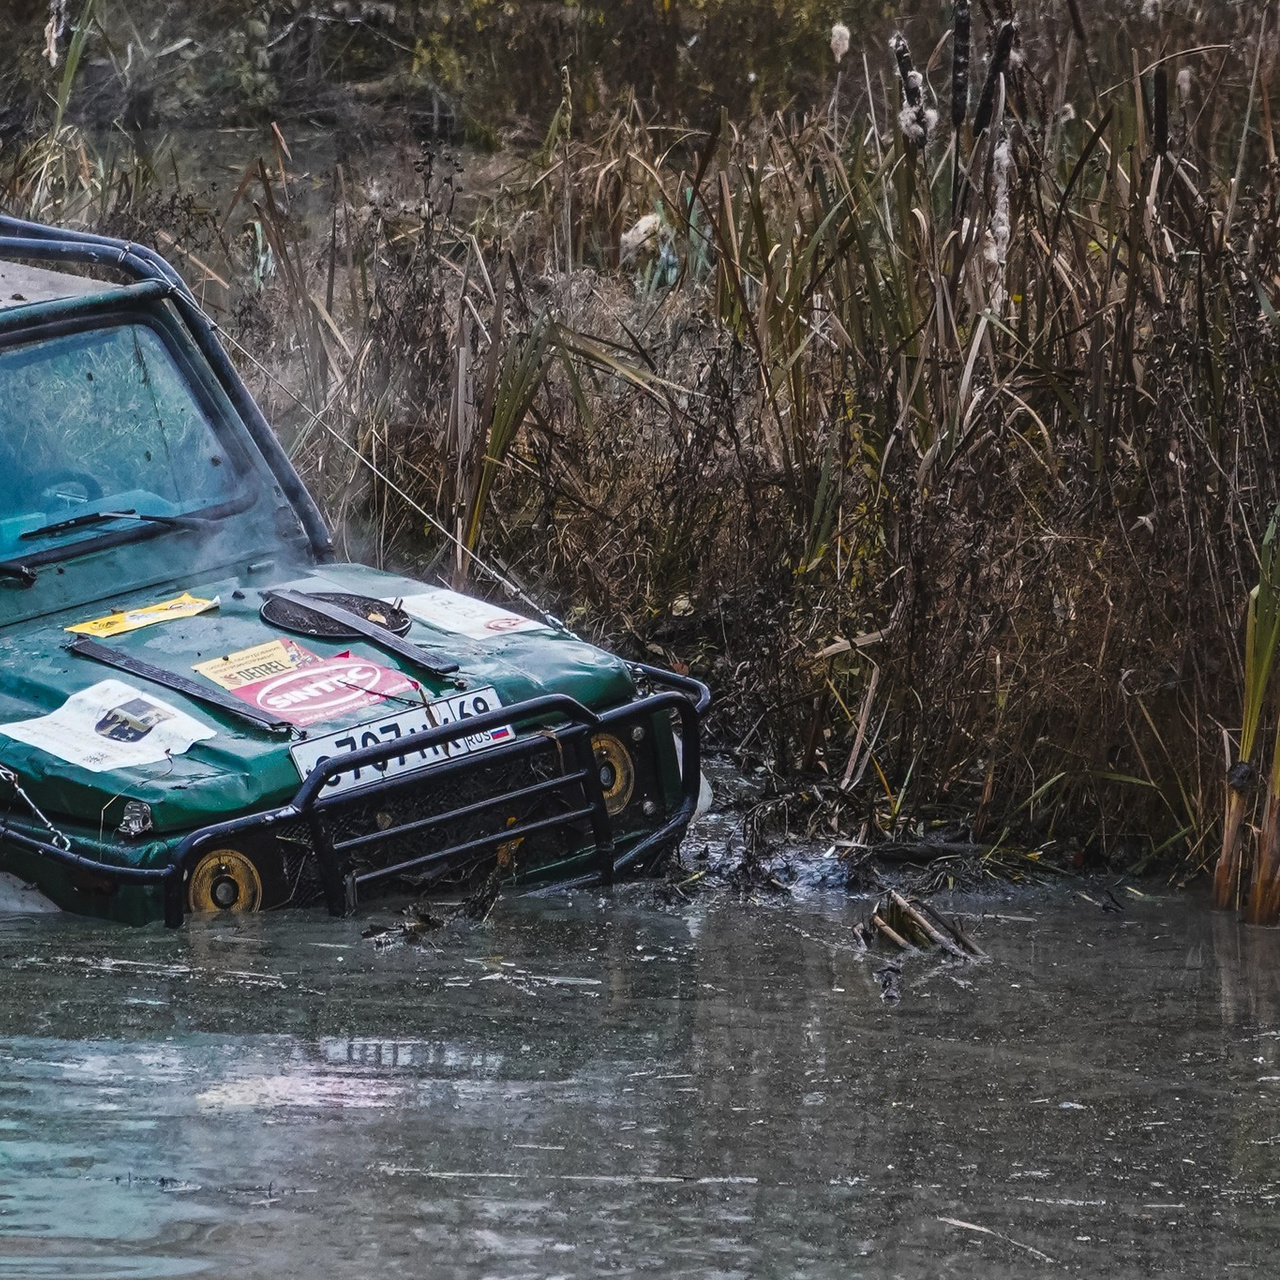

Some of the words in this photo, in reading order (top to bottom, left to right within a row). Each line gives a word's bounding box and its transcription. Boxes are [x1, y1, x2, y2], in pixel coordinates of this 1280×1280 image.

[236, 660, 292, 682] DENZEL
[266, 666, 374, 710] SINTEC
[467, 730, 492, 747] RUS
